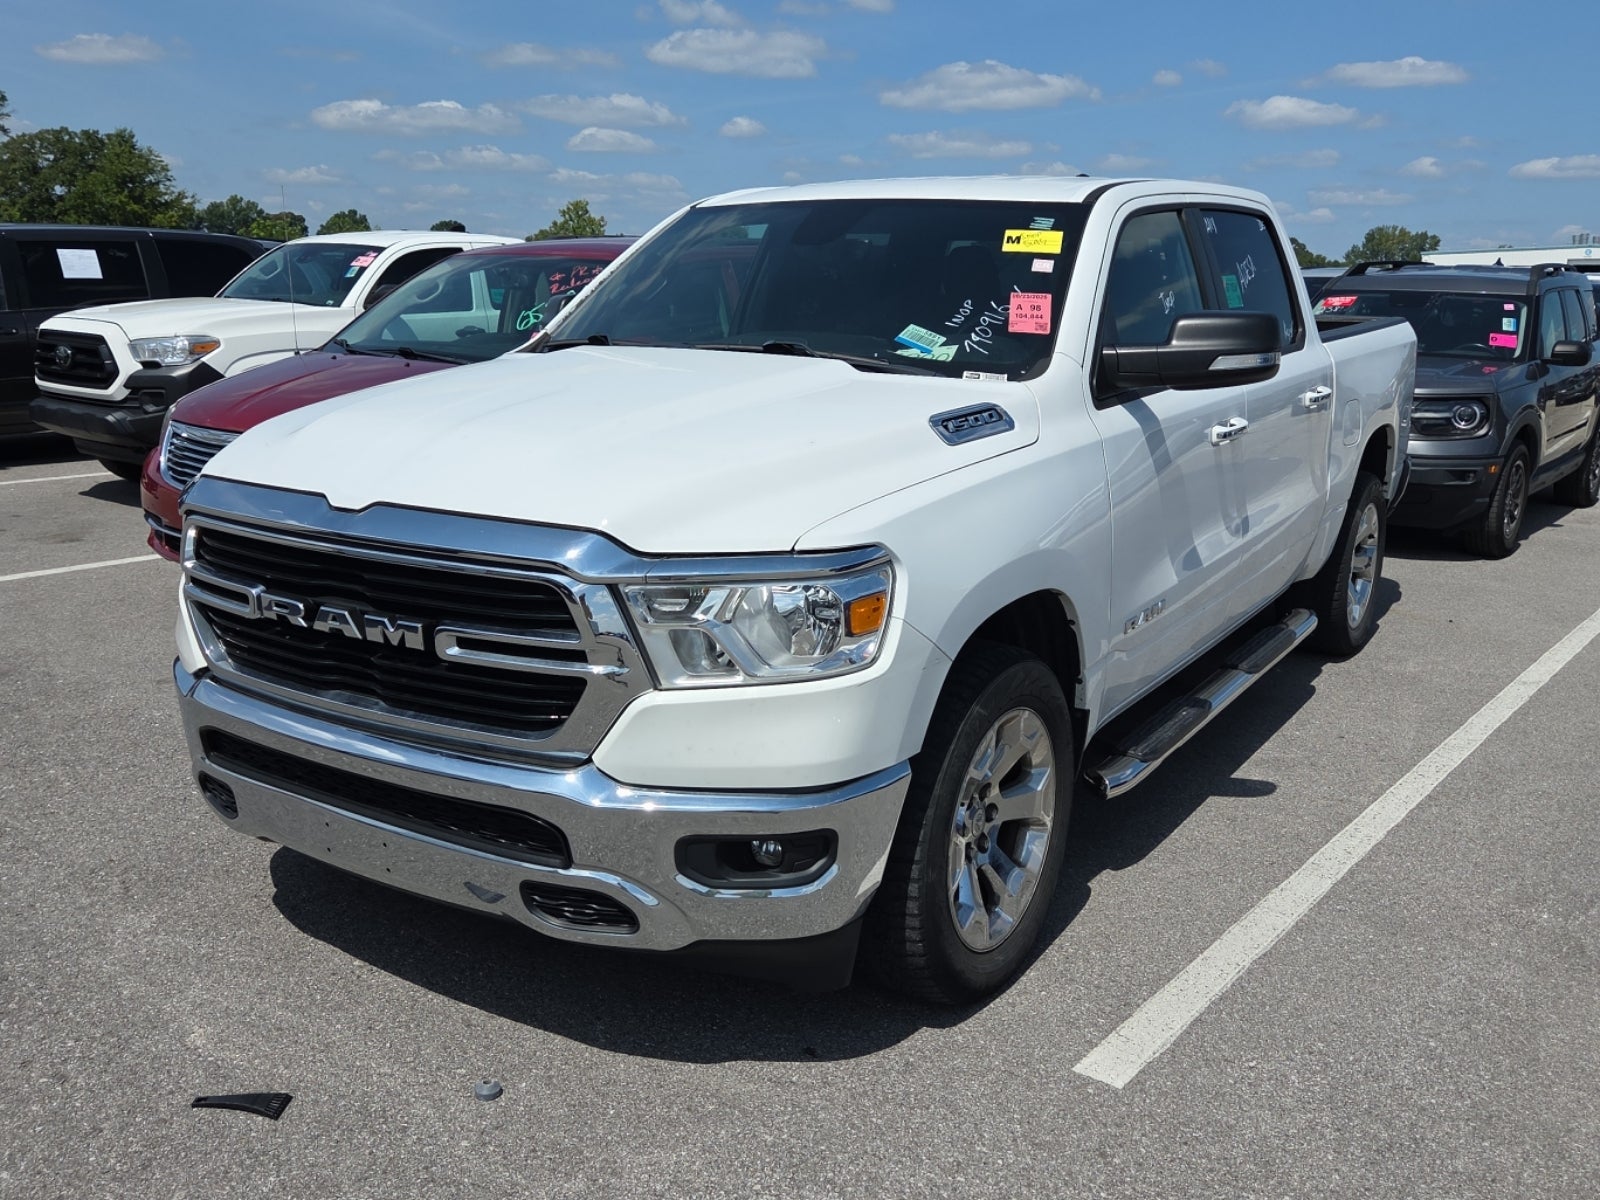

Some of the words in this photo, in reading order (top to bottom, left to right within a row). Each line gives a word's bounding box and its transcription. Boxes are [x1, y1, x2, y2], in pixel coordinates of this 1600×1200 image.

[1005, 235, 1021, 244] M
[942, 410, 1003, 433] 1500
[260, 592, 425, 651] RAM
